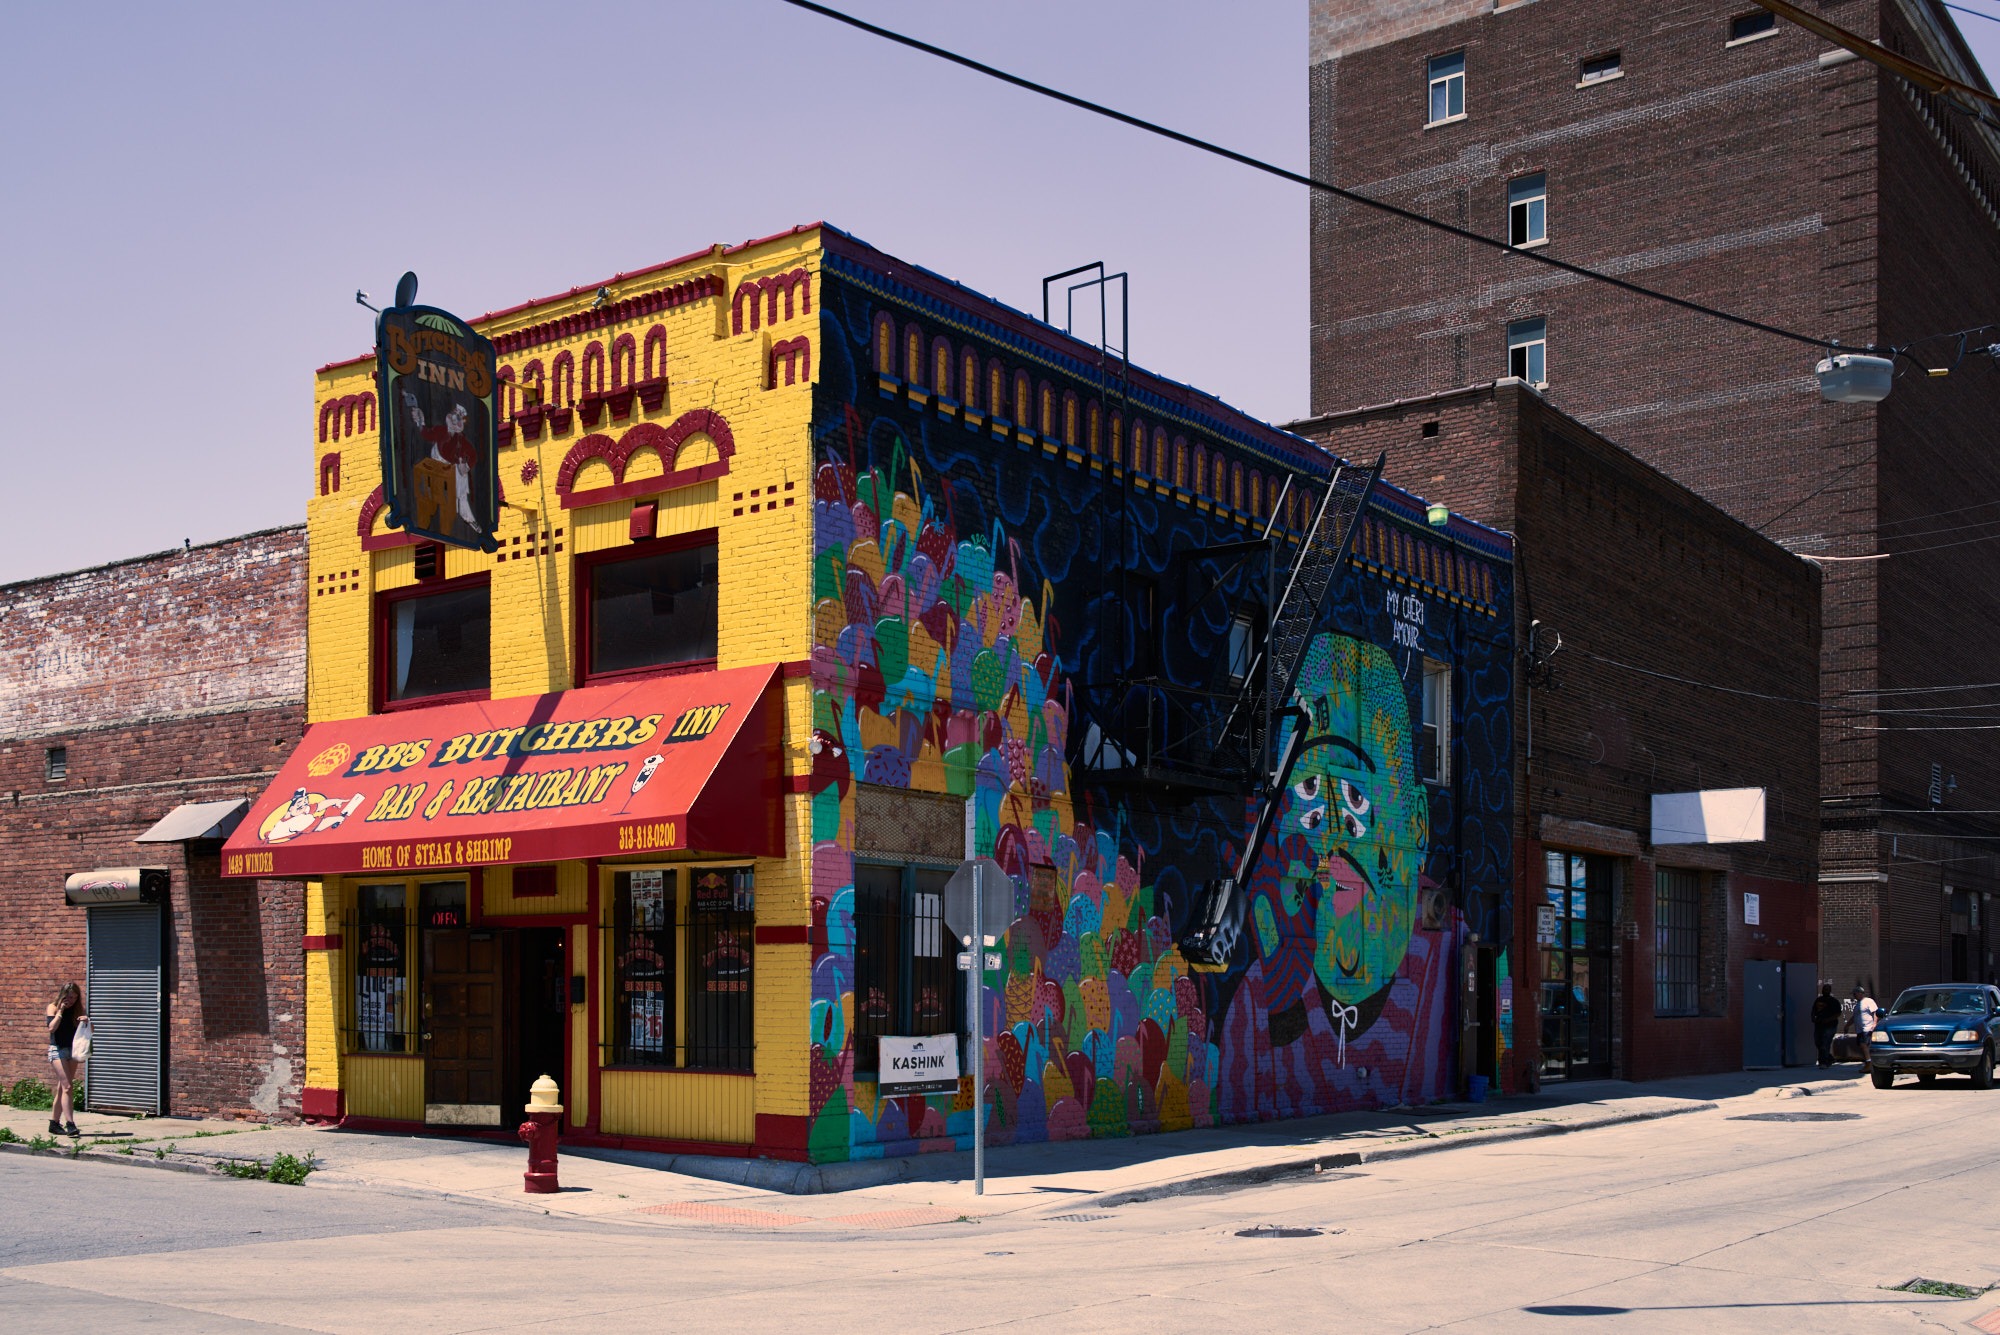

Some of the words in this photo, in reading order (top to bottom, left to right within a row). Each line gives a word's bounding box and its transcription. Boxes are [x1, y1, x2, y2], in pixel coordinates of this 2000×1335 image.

[418, 359, 464, 391] INN
[1386, 589, 1400, 615] MY
[350, 739, 432, 773] BB'S
[436, 713, 664, 765] BUTCHERS
[669, 703, 731, 738] INN
[365, 783, 427, 822] BAR
[423, 779, 454, 820] &
[448, 761, 628, 816] RESTAURANT
[619, 822, 676, 850] 313-818-0200
[228, 855, 243, 874] 1489
[245, 852, 273, 873] WINDER
[362, 846, 393, 868] HOME
[396, 845, 411, 867] OF
[415, 843, 452, 865] STEAK
[455, 841, 464, 864] &
[466, 837, 512, 862] SHRIMP
[892, 1055, 944, 1070] KASHINK
